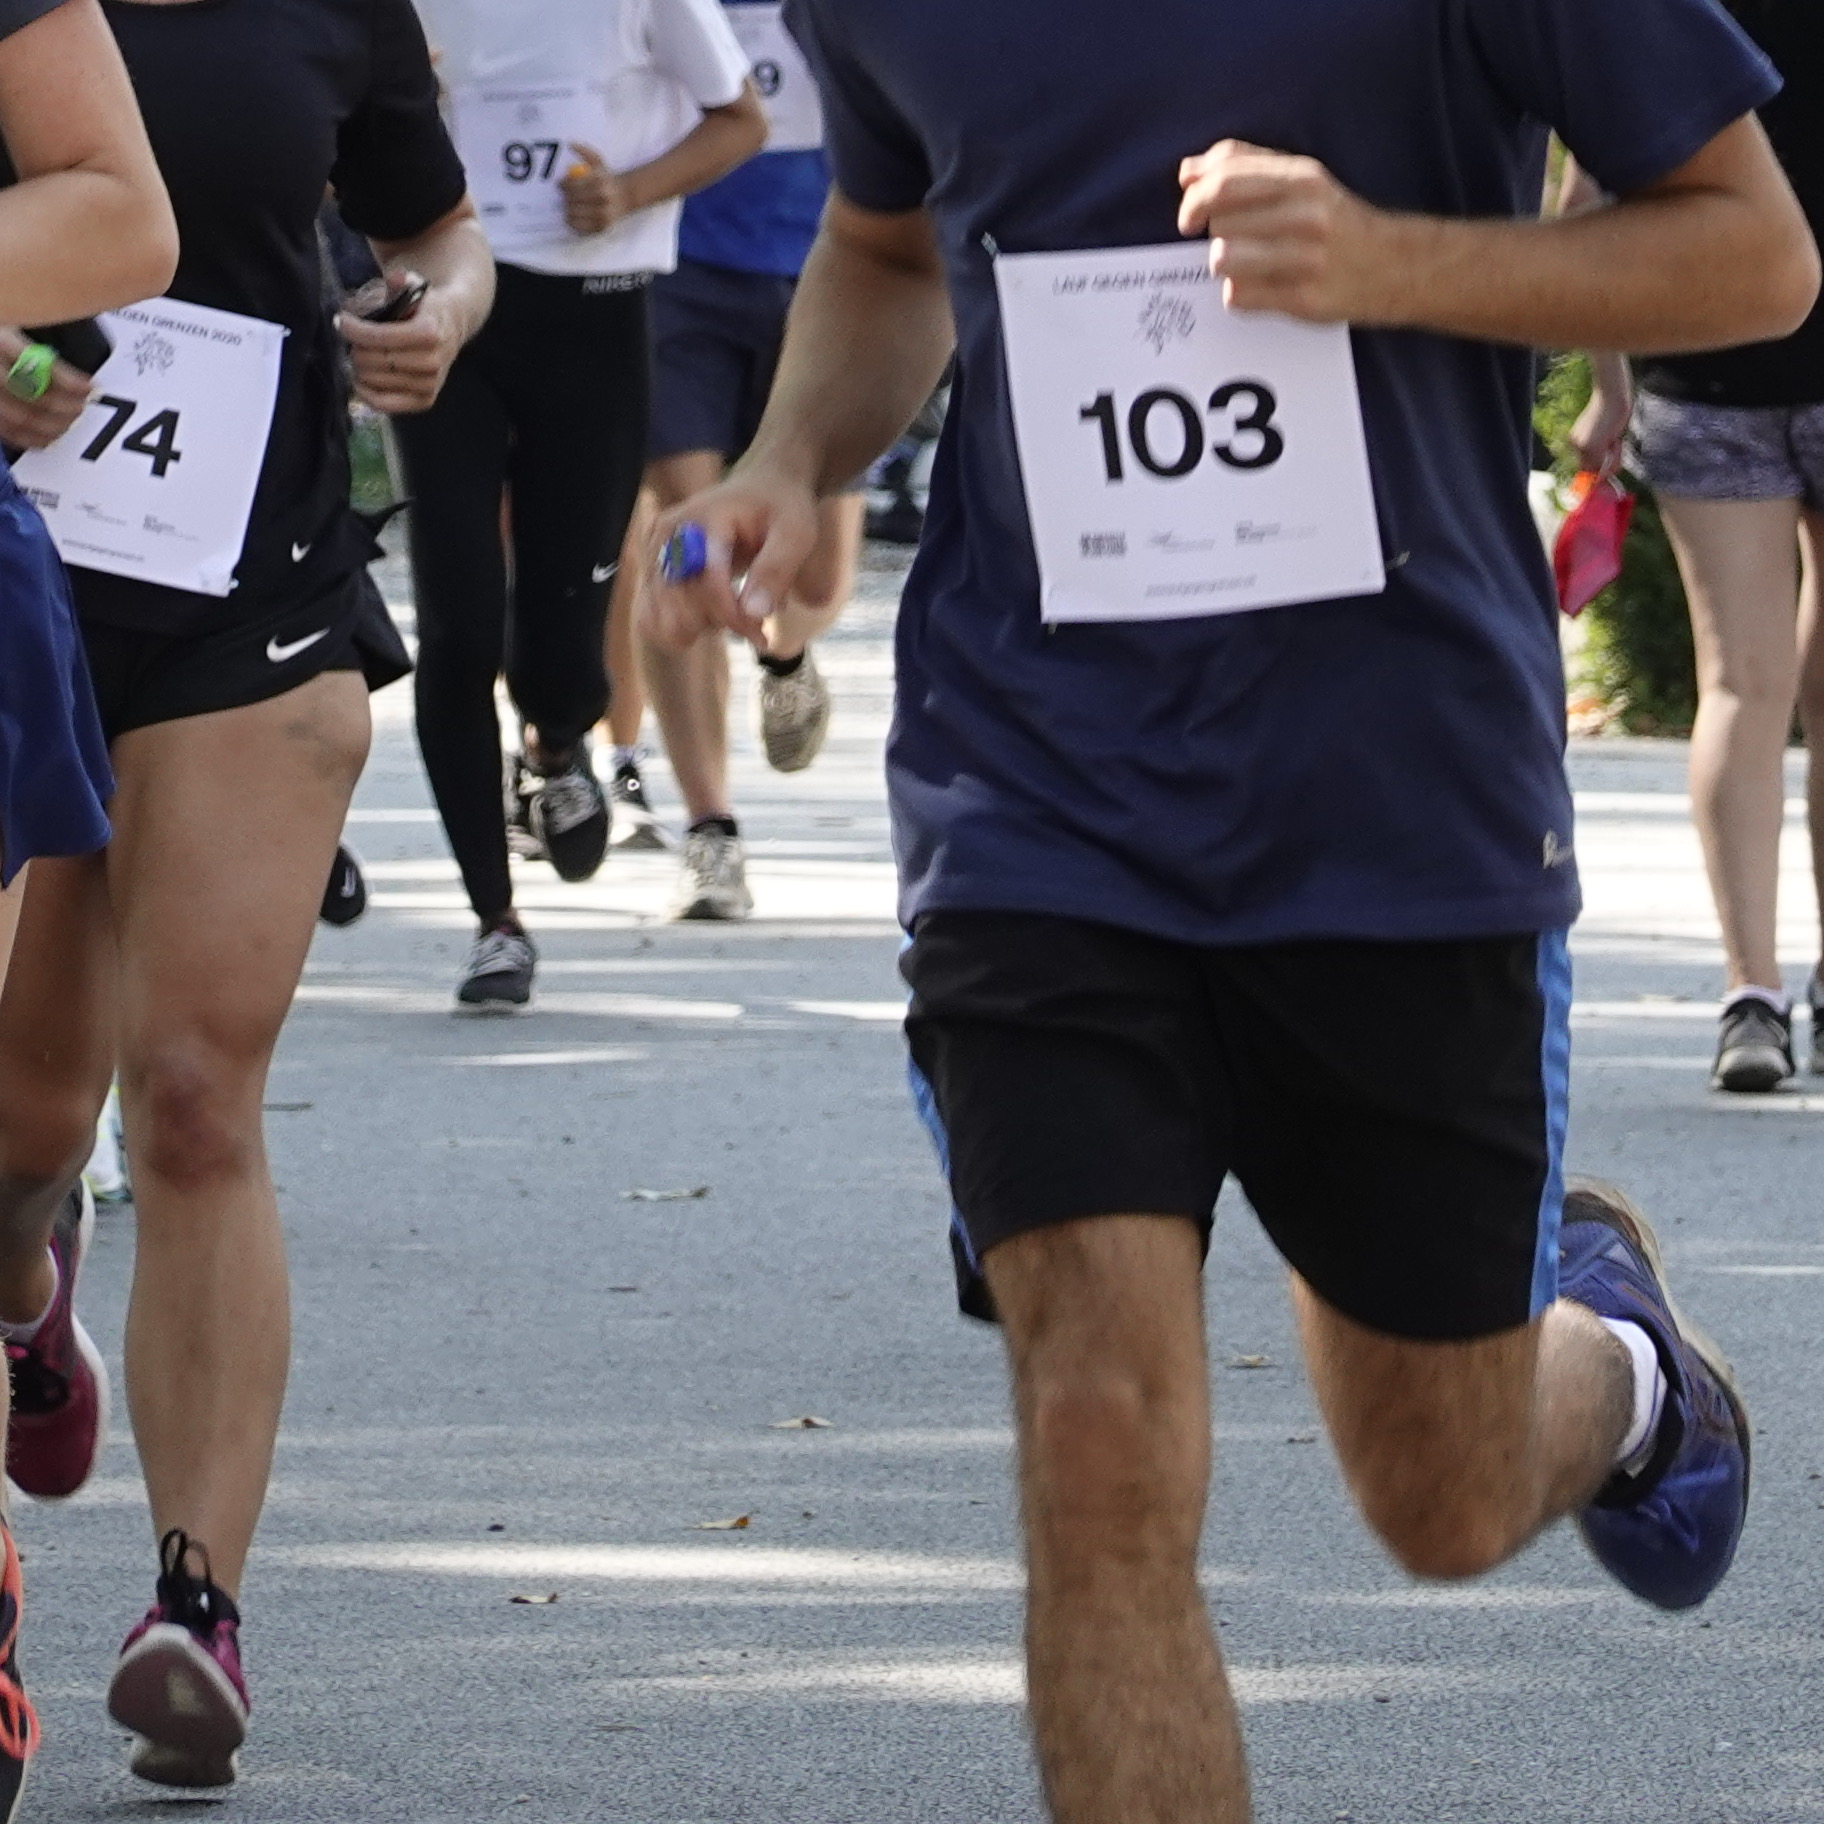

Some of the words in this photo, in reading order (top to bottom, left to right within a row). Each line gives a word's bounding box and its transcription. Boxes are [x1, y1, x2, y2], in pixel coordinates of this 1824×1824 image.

[503, 141, 560, 182] 97
[151, 314, 208, 339] GRENZEN
[210, 328, 242, 347] 2020
[80, 394, 181, 479] 74
[1079, 379, 1284, 482] 103
